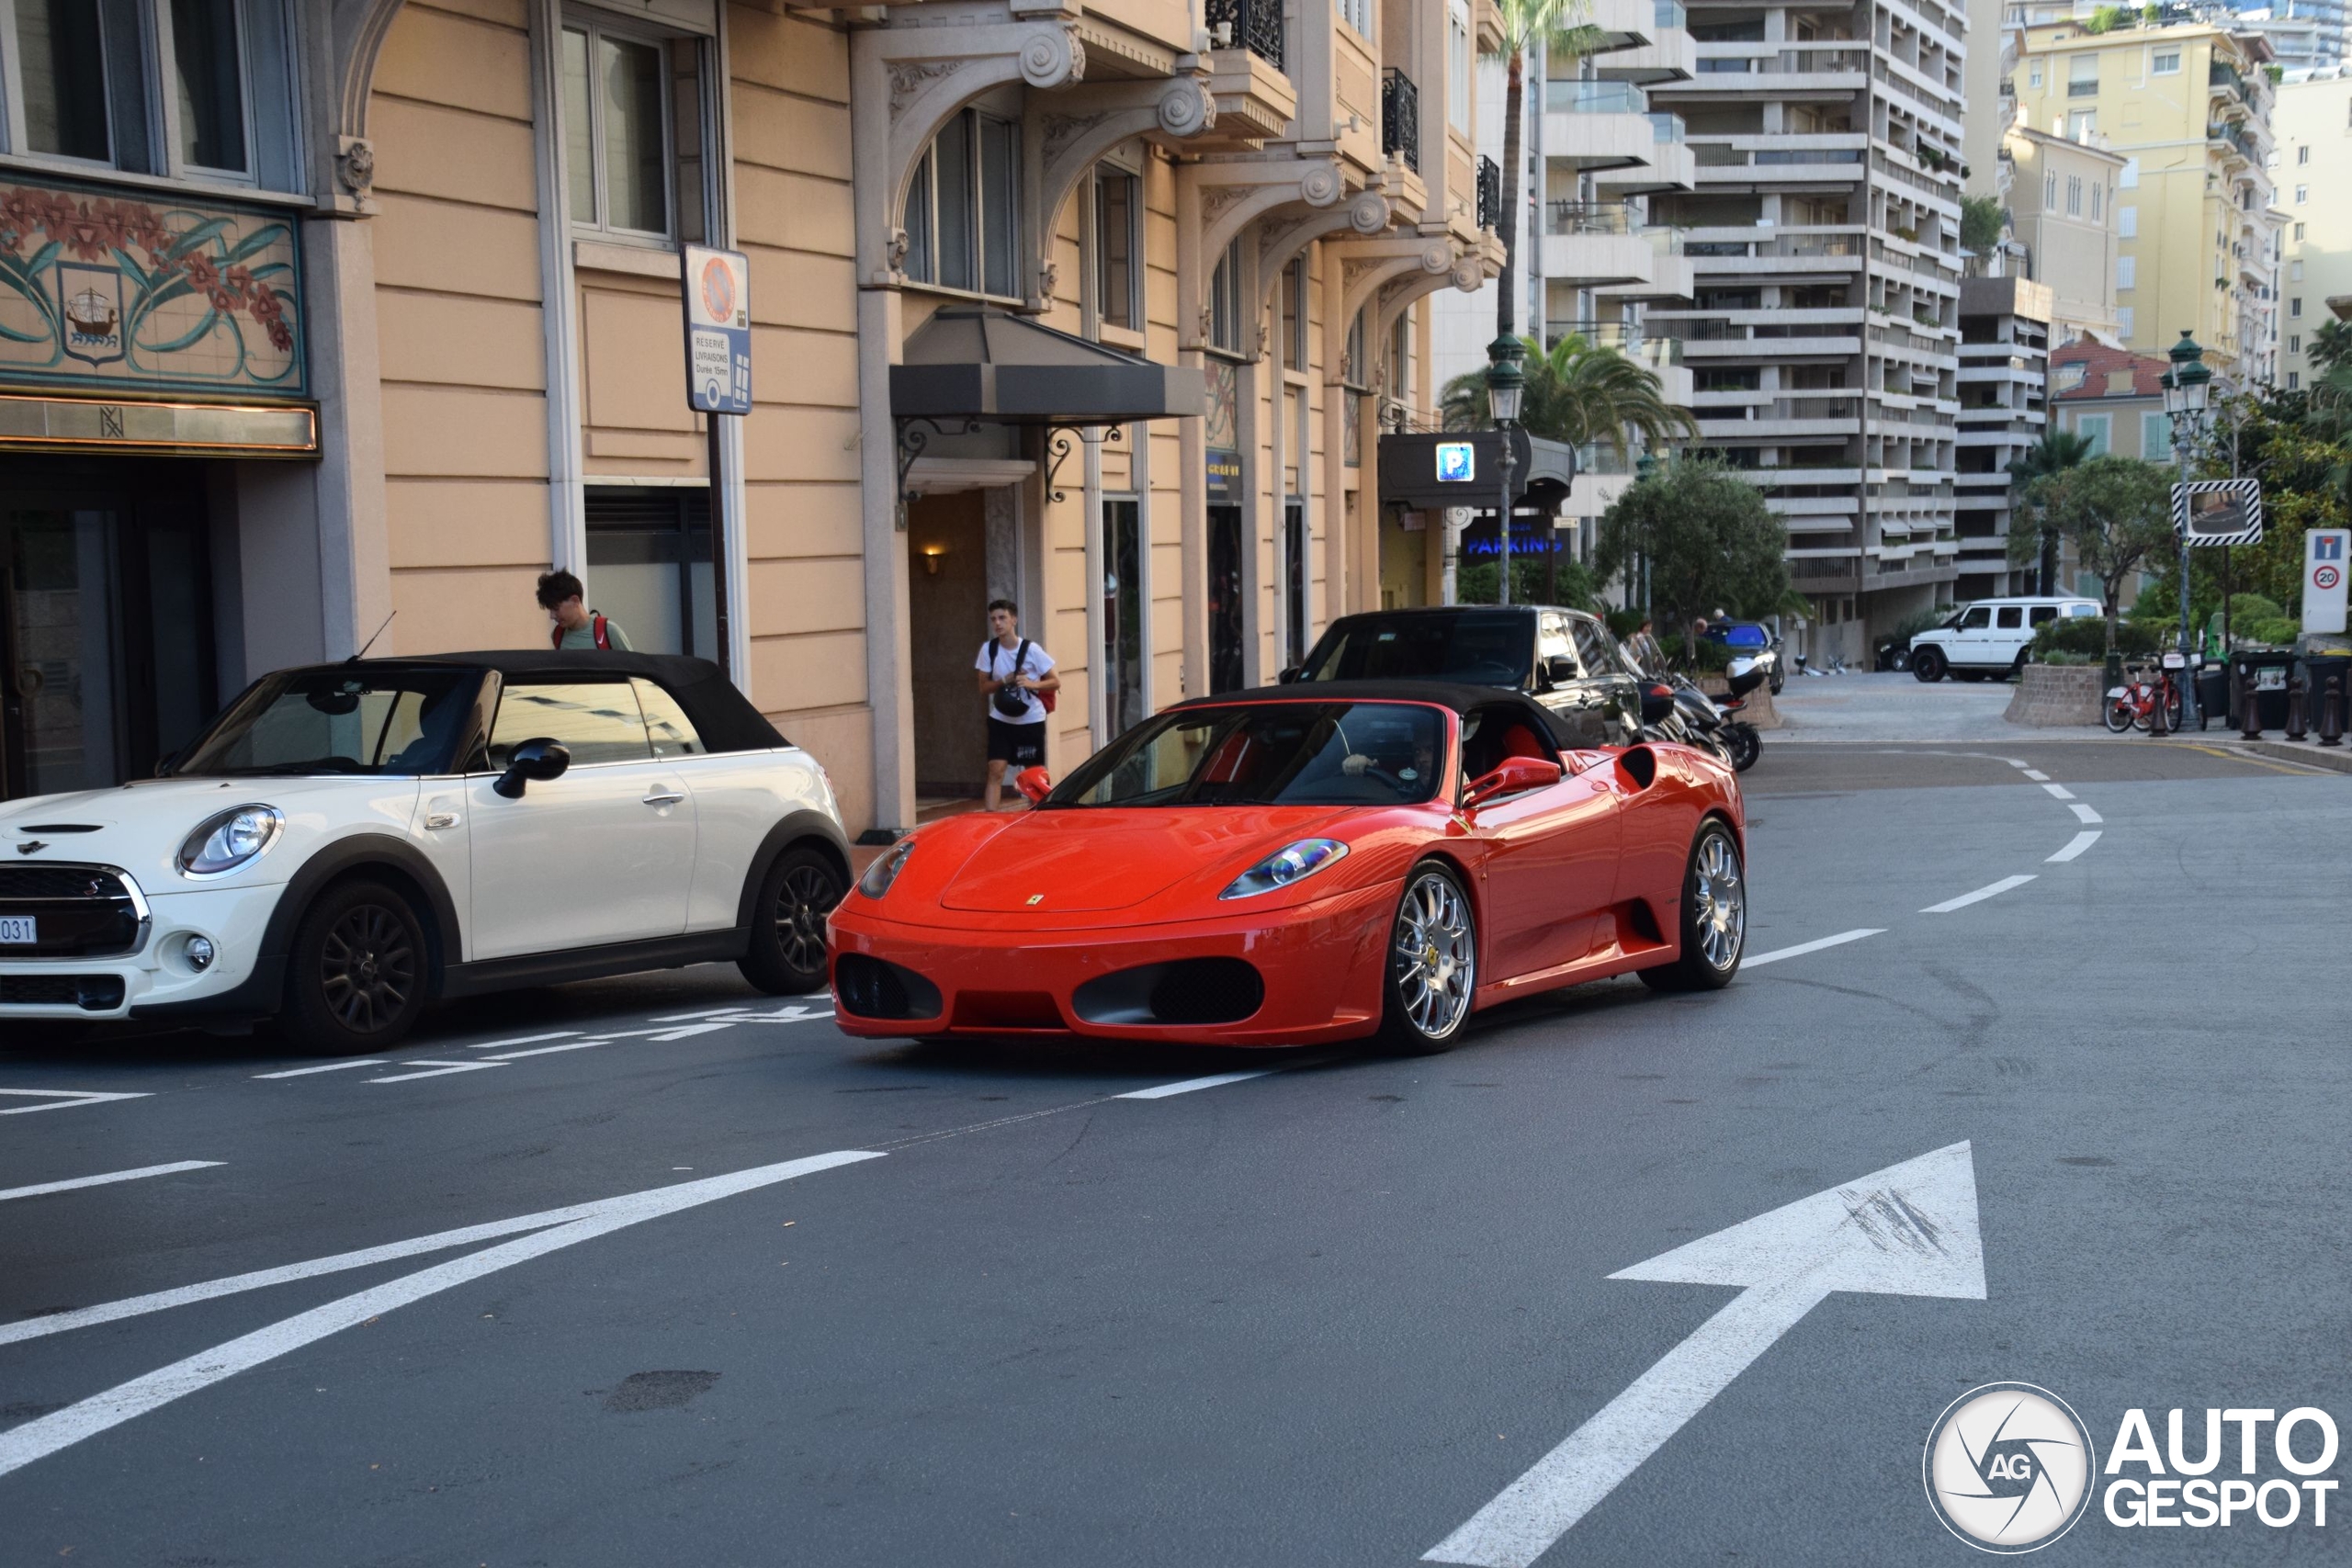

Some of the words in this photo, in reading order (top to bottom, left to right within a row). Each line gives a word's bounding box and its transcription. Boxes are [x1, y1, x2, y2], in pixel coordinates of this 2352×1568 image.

[695, 351, 729, 363] LIVRAISONS
[1446, 451, 1464, 475] P
[1467, 536, 1563, 554] PARKING
[2319, 572, 2335, 582] 20
